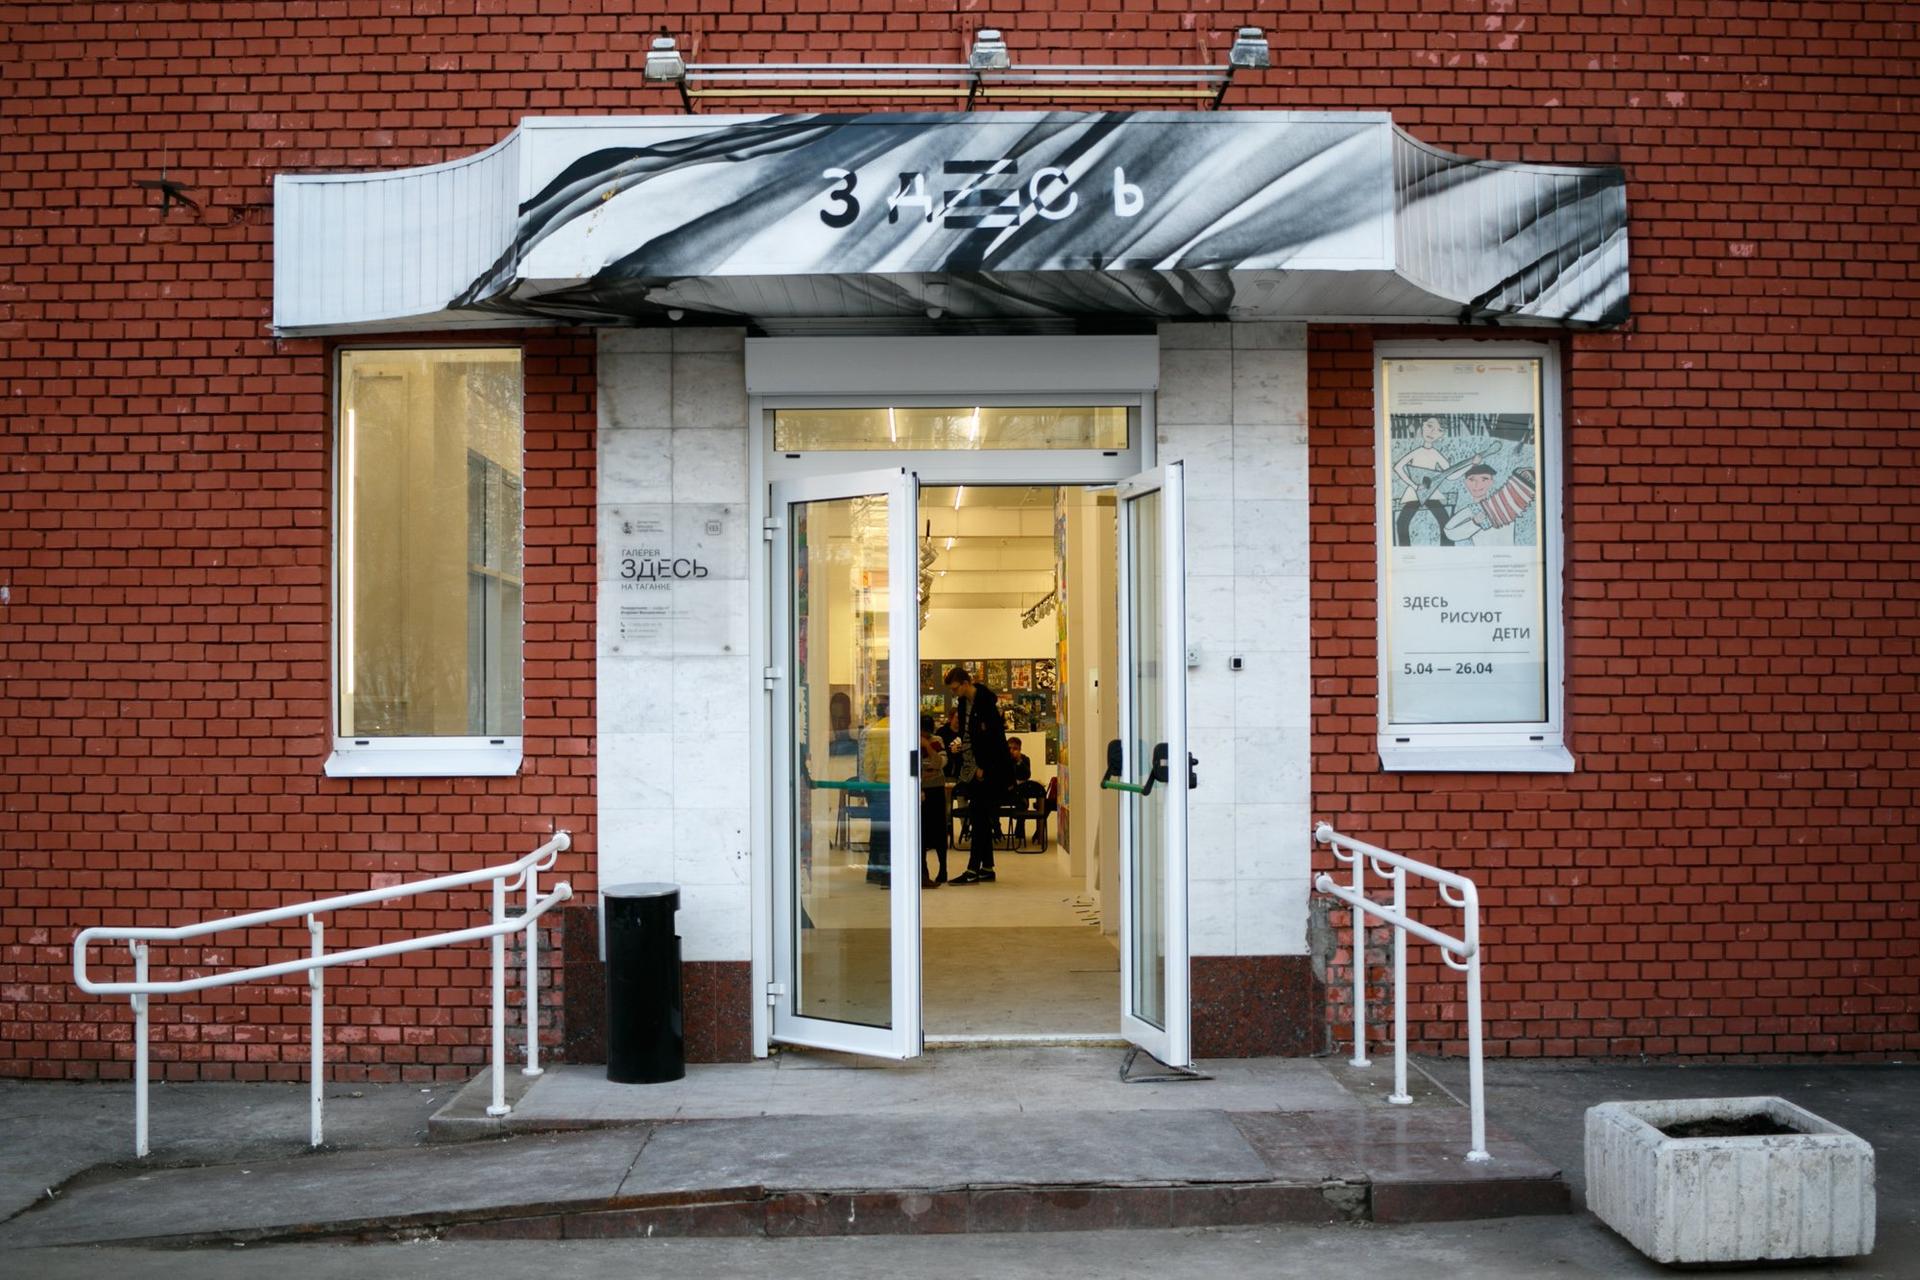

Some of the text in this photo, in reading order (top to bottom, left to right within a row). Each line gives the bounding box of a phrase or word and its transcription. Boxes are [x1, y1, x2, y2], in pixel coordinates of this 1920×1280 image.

[621, 549, 661, 557] ГАЛЕРЕЯ
[620, 558, 708, 582] ЗДЕСЬ
[1402, 596, 1449, 611] ЗДЕСЬ
[1440, 611, 1502, 623] РИСУЮТ
[1492, 627, 1531, 642] ДЕТИ
[1403, 662, 1433, 675] 5.04
[1455, 662, 1493, 675] 26.04
